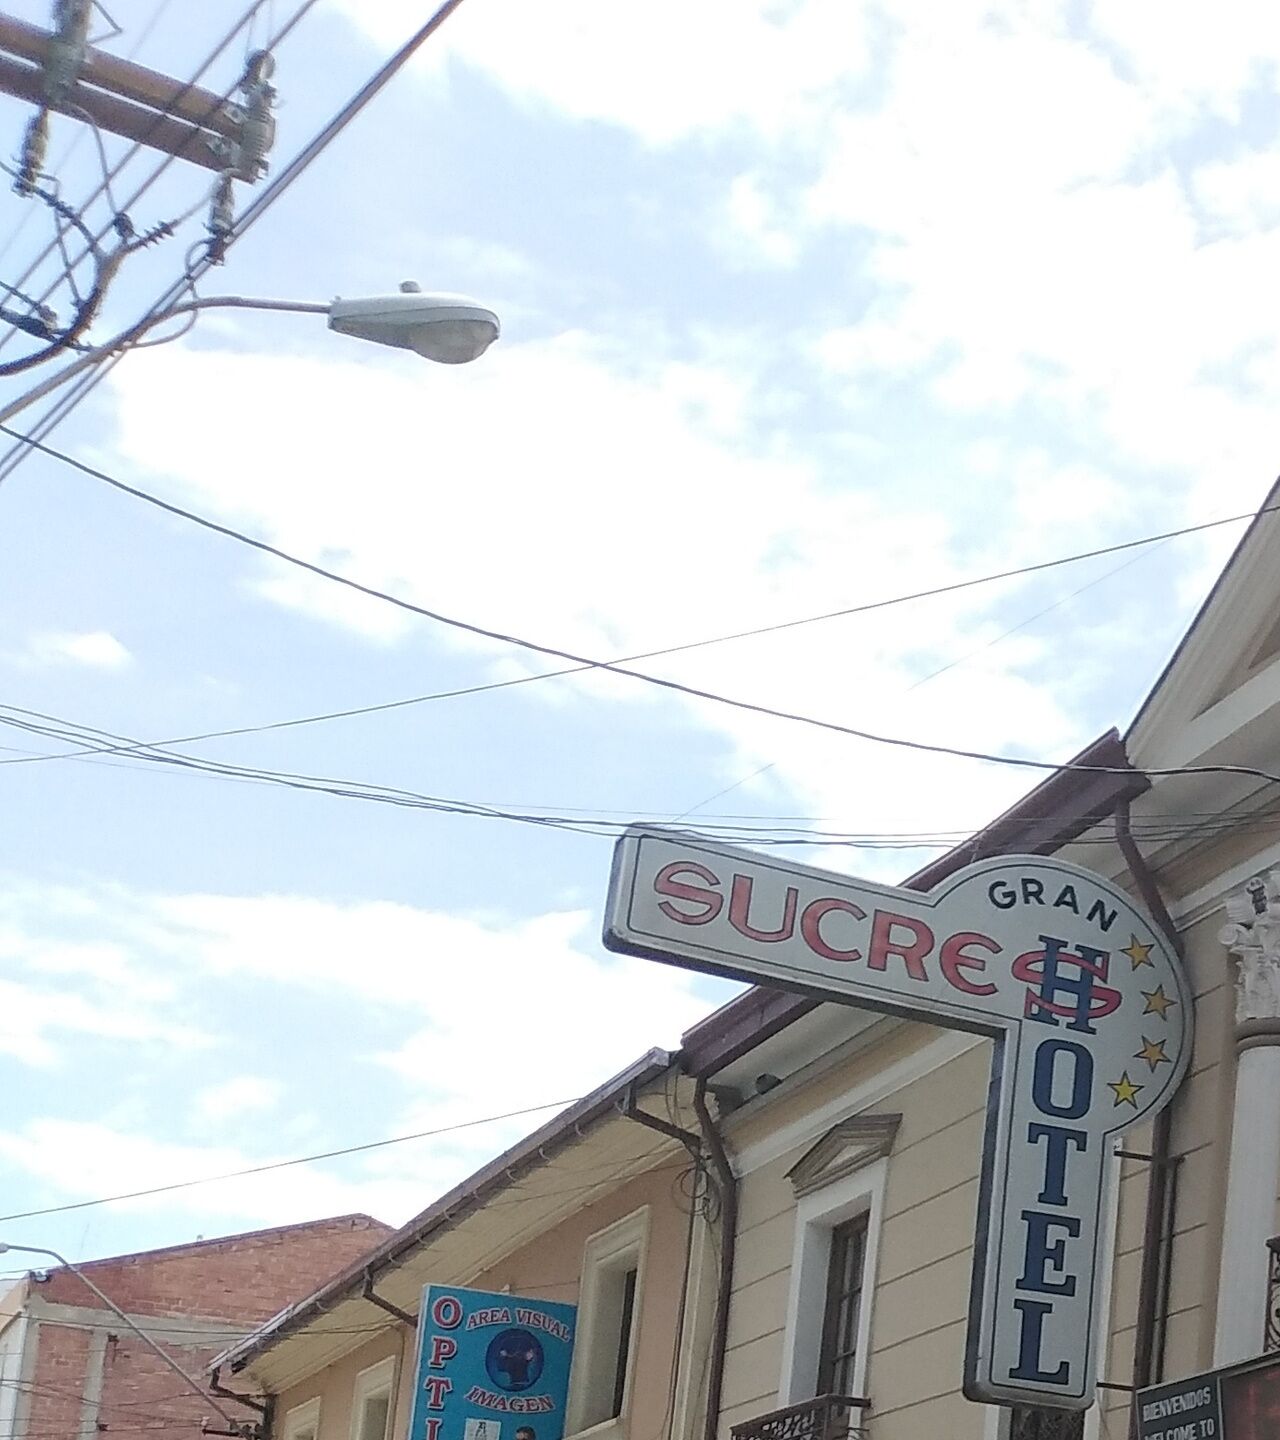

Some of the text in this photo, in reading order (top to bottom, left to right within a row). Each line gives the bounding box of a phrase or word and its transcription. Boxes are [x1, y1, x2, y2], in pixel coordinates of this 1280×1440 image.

[988, 877, 1119, 934] GRAN
[654, 861, 1003, 997] SUCRE
[1009, 934, 1112, 1387] HOTEL
[466, 1307, 571, 1342] AREA VISUAL
[465, 1385, 554, 1413] IMAGEN
[1143, 1386, 1211, 1422] BIENVENIDOS
[1200, 1418, 1215, 1437] TO
